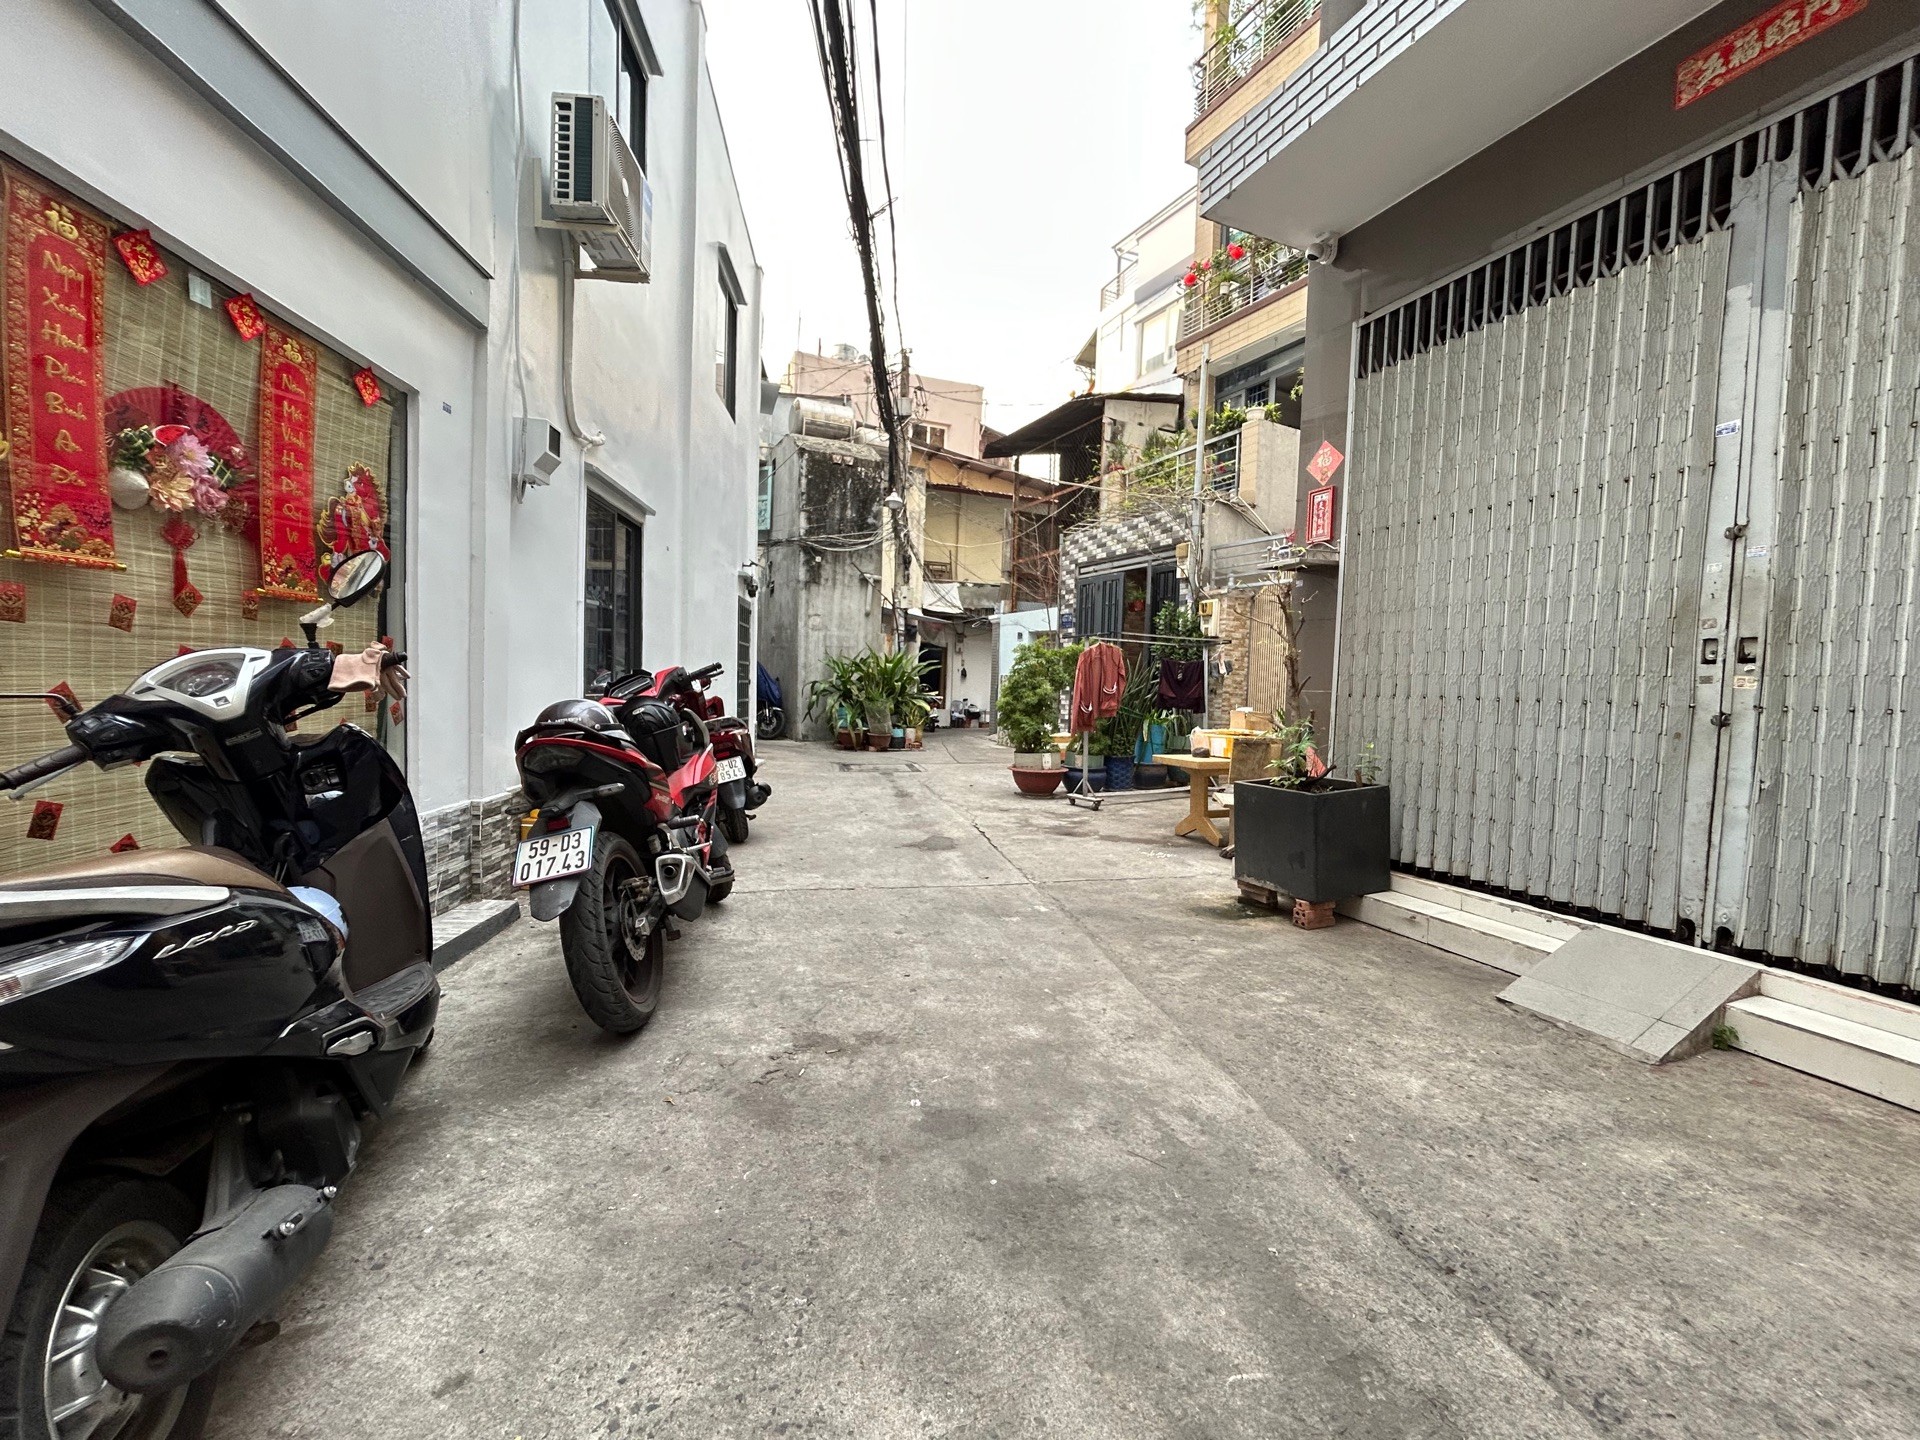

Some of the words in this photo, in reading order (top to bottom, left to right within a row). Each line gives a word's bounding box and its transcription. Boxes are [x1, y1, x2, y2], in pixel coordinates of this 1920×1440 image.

[44, 201, 79, 240] 福
[42, 250, 85, 298] Ngày
[42, 286, 87, 321] Xuân
[283, 337, 302, 364] 福
[43, 355, 87, 386] Phúc
[55, 429, 83, 452] An
[281, 422, 305, 448] Vinh
[281, 449, 304, 471] Hoa
[1317, 447, 1333, 467] 福
[528, 832, 582, 859] 59-D3
[520, 851, 585, 882] 017.43
[152, 919, 259, 960] LEAD
